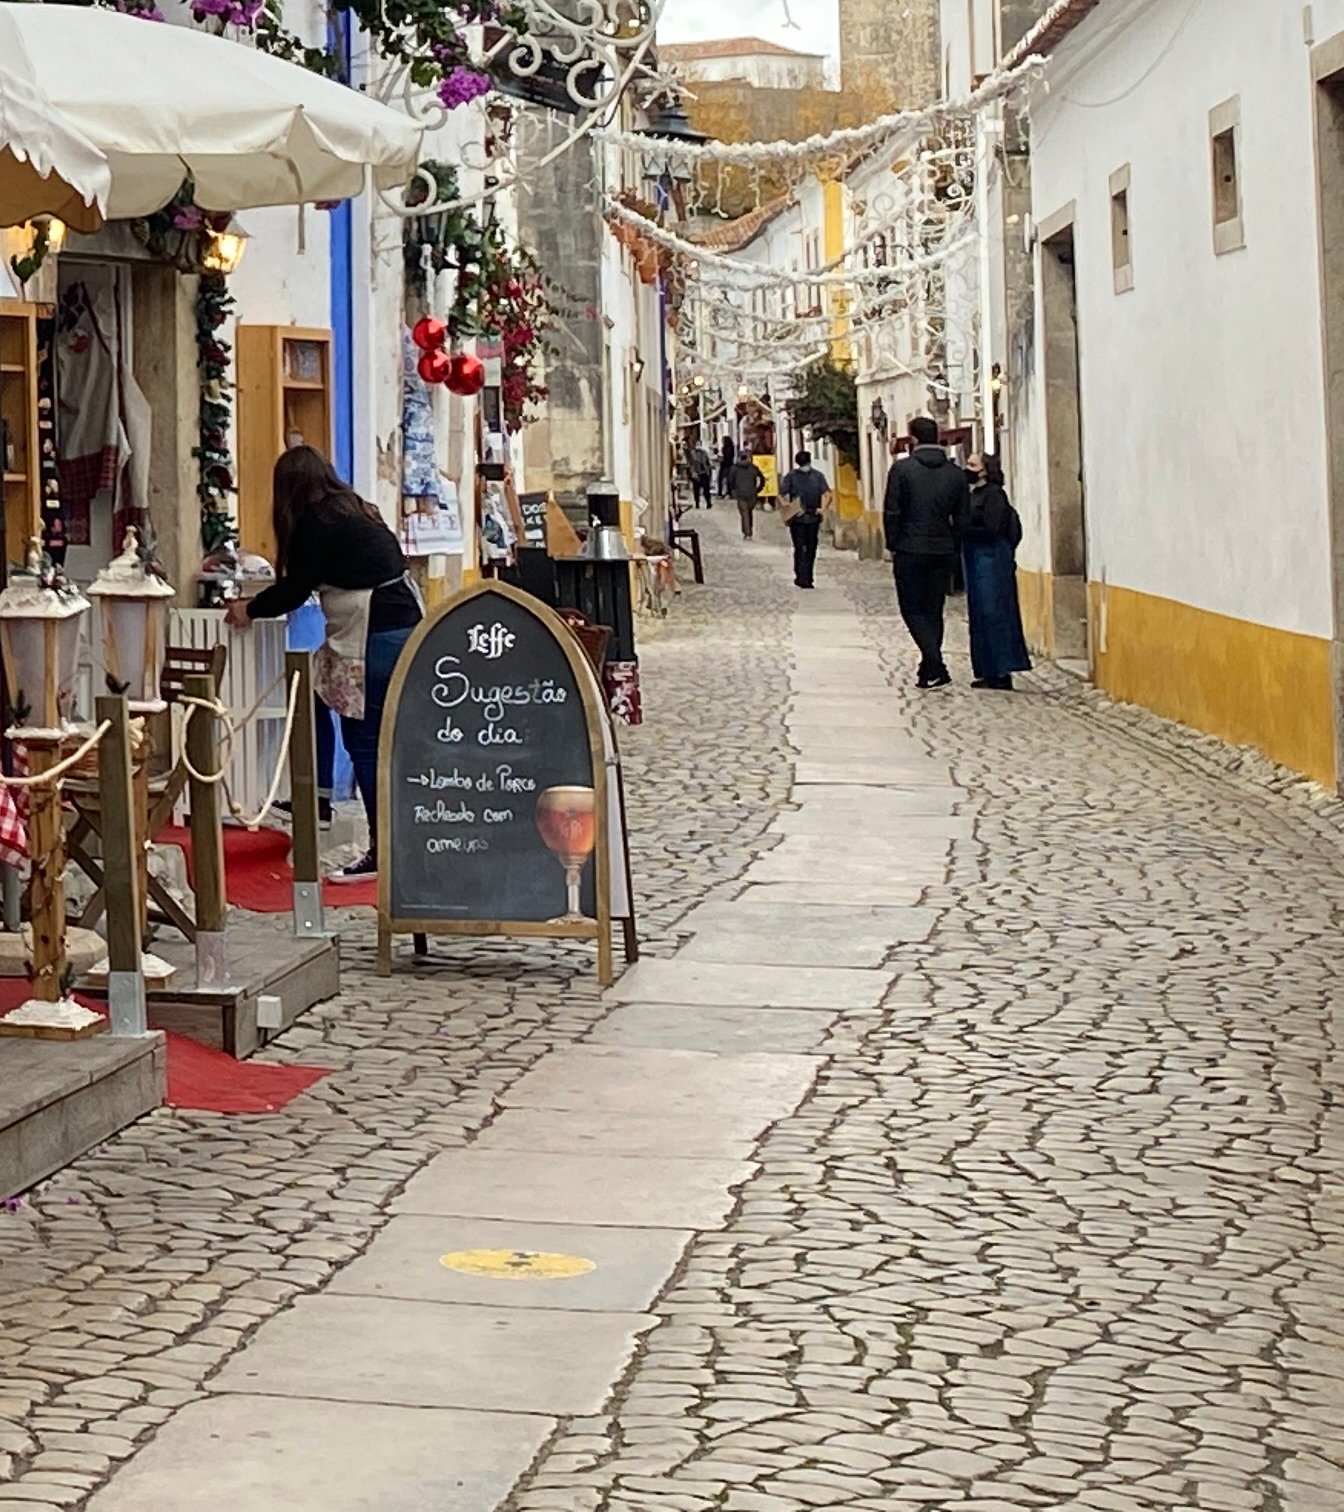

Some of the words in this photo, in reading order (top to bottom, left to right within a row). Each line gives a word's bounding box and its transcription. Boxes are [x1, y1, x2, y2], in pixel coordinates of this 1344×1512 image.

[467, 622, 516, 658] Leffe
[431, 656, 566, 721] Sugestão
[437, 717, 464, 743] do
[475, 772, 495, 792] de
